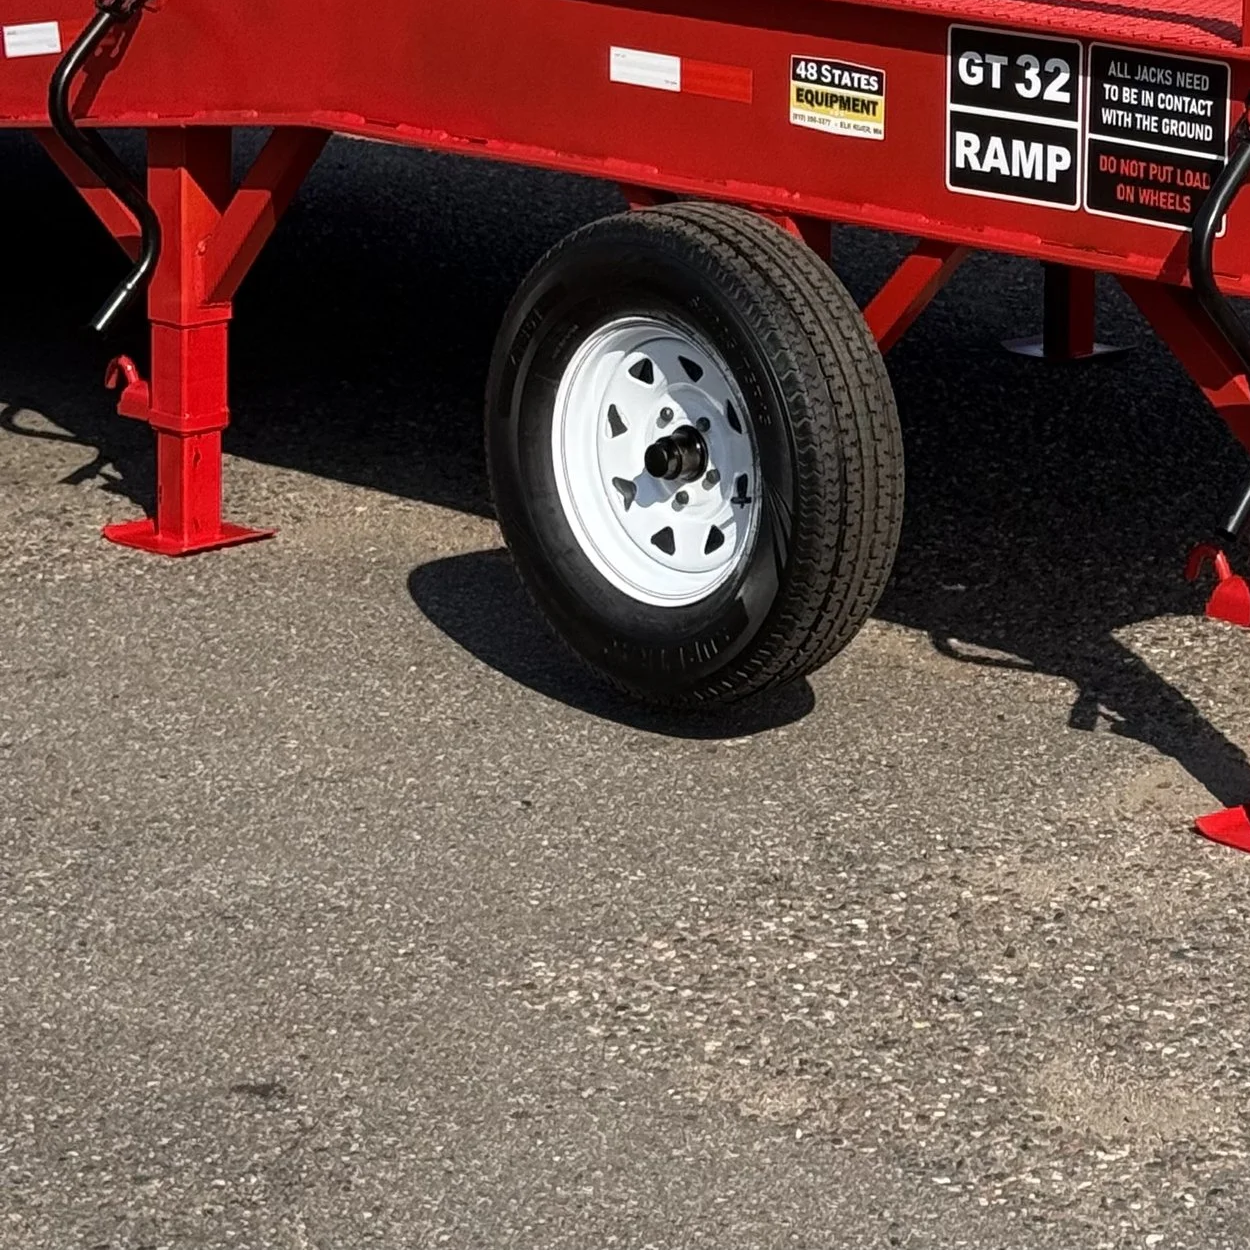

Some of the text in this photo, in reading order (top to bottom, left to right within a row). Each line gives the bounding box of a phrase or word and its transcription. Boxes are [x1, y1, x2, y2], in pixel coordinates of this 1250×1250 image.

[796, 61, 879, 91] 48 STATES
[958, 51, 1071, 104] GT 32
[1108, 60, 1210, 91] ALL JACKS NEED
[796, 87, 879, 117] EQUIPMENT
[1103, 83, 1214, 117] TO BE IN CONTACT
[1101, 107, 1213, 142] WITH THE GROUND
[955, 131, 1071, 183] RAMP
[1100, 155, 1211, 190] DO NOT PUT LOAD
[1117, 183, 1192, 213] ON WHEELS
